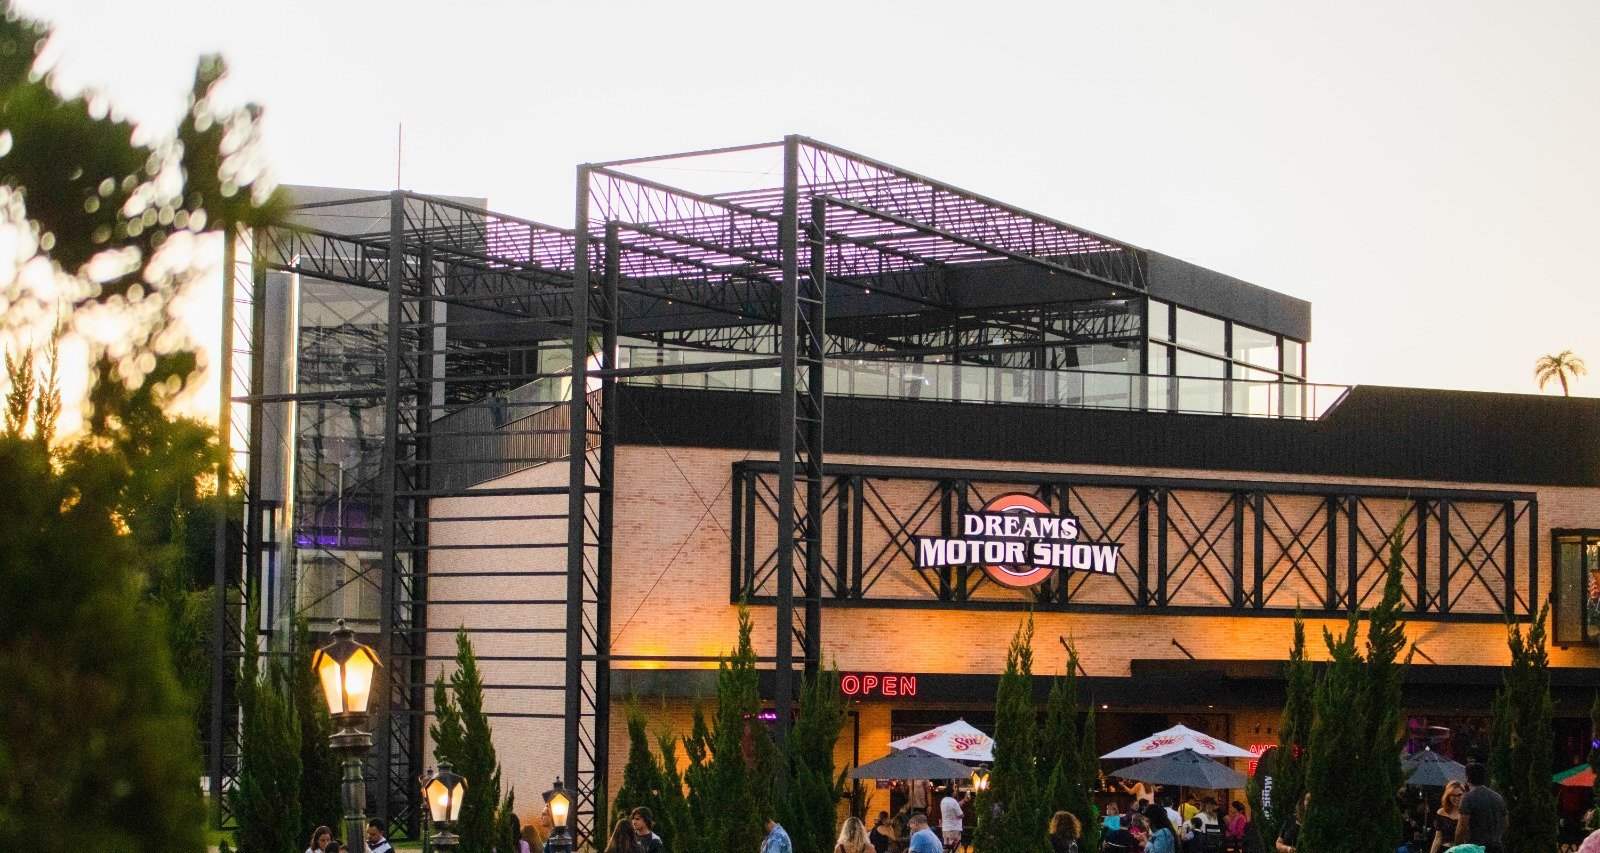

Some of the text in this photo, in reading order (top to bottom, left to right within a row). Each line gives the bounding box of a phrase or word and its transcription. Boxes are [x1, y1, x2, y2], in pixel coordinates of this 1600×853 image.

[964, 514, 1078, 540] DREAMS
[920, 539, 1118, 574] MOTOR SHOW
[841, 675, 917, 697] OPEN
